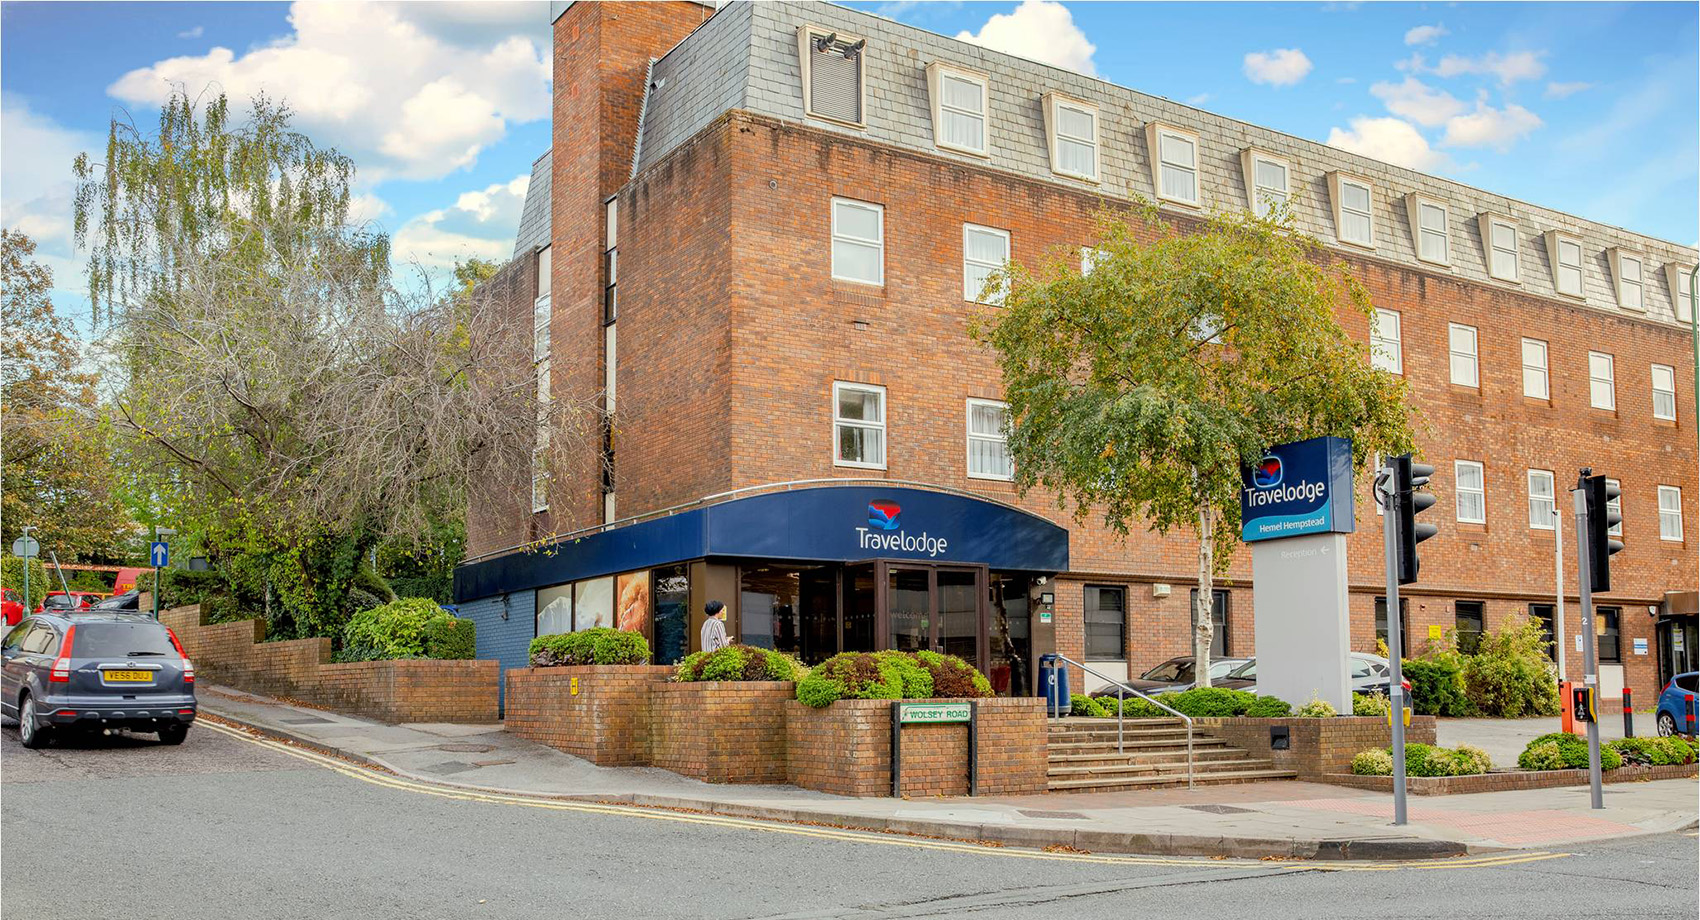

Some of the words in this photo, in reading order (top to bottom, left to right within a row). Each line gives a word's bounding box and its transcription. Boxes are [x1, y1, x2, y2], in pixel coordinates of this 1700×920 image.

[1245, 480, 1325, 507] Travelodge
[1260, 522, 1282, 533] Hemel
[1283, 516, 1325, 530] Hempstead
[855, 527, 948, 557] Travelodge
[1281, 547, 1317, 559] Reception
[1582, 617, 1588, 625] 2
[109, 671, 131, 679] VE56
[910, 710, 943, 719] WOLSEY
[946, 710, 968, 718] ROAD
